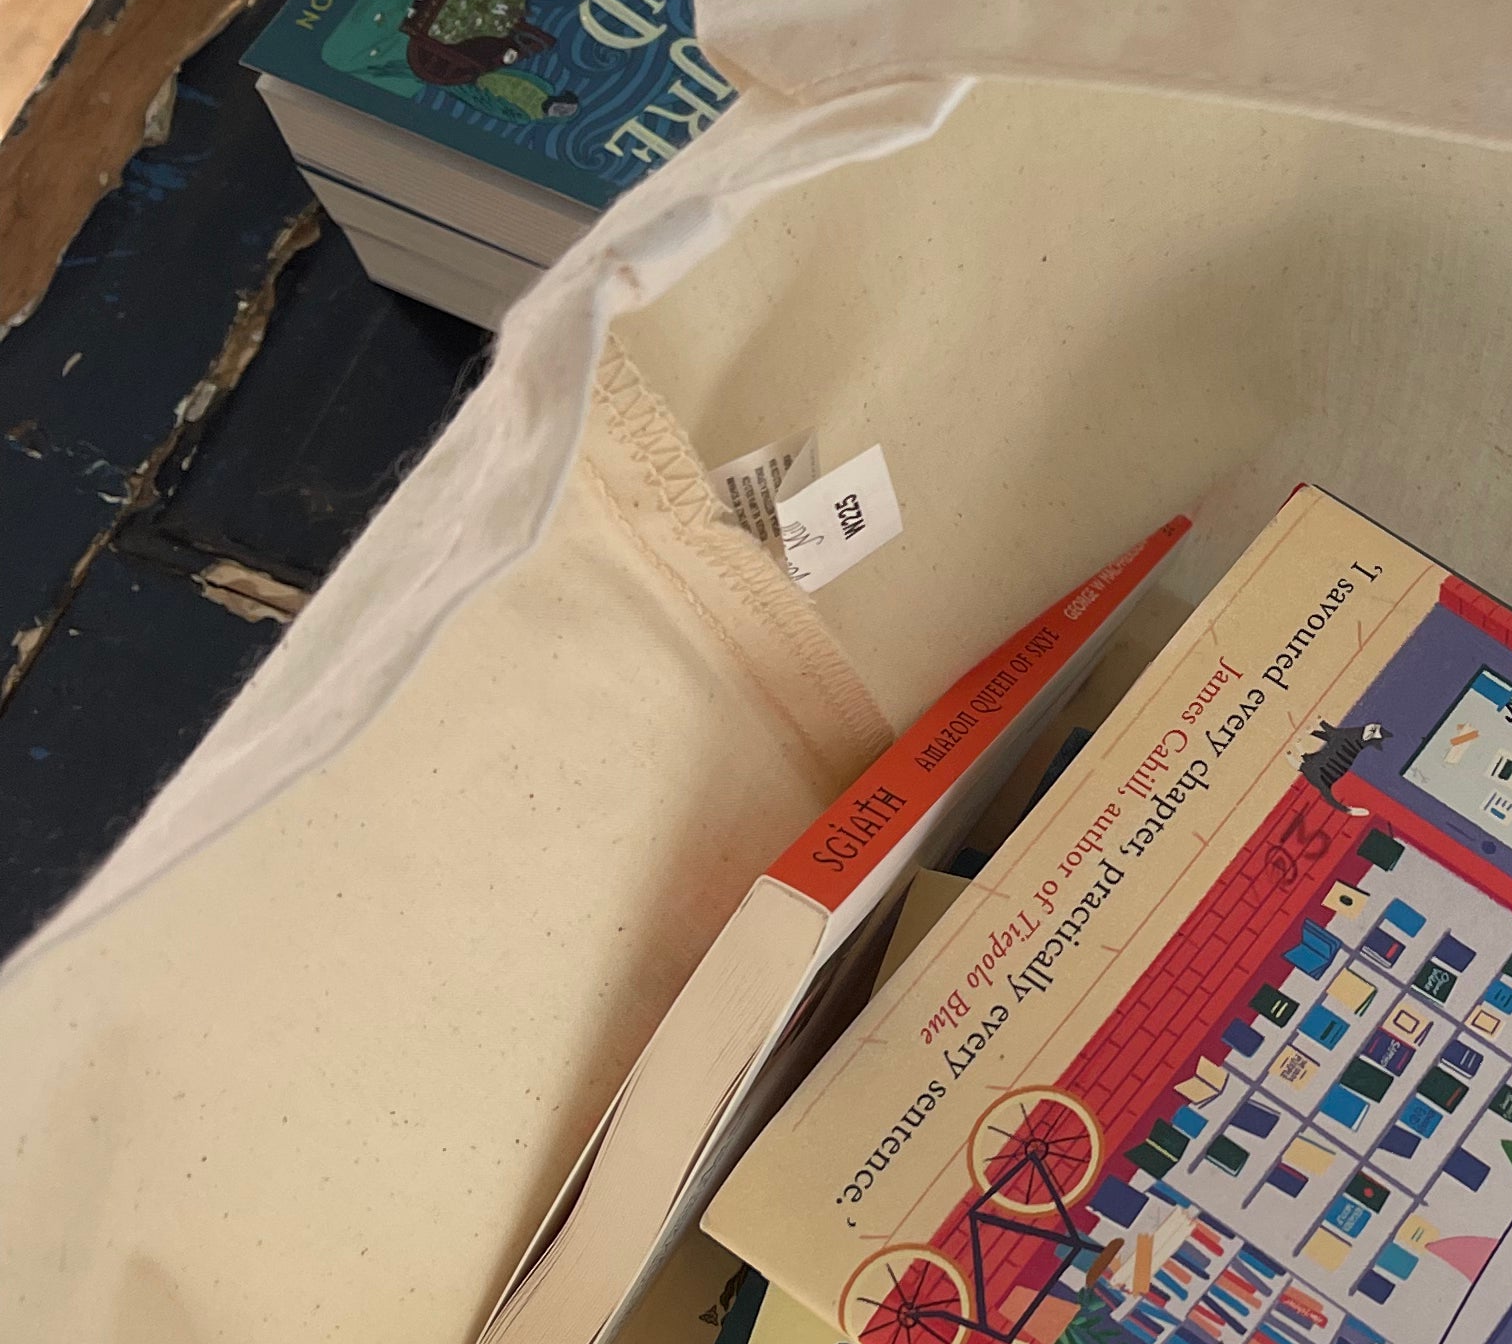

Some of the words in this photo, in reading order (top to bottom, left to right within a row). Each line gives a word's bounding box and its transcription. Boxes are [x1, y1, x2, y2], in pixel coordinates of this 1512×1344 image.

[834, 493, 866, 541] W225
[1063, 586, 1100, 622] GEORGE
[1262, 578, 1354, 690] savoured
[913, 710, 979, 773] AMAZON
[970, 670, 1017, 715] QUEEN
[1009, 653, 1035, 677] OF
[1024, 625, 1061, 658] SKYE
[1181, 656, 1244, 724] James
[1205, 689, 1265, 758] every
[1118, 729, 1188, 799] Cahill,
[1057, 803, 1121, 879] author
[1119, 760, 1210, 857] chapter,
[1007, 858, 1125, 1003] practically
[1033, 880, 1059, 915] of
[966, 910, 1041, 989] Tiepolo
[920, 989, 971, 1045] Blue
[943, 1004, 1009, 1080] every
